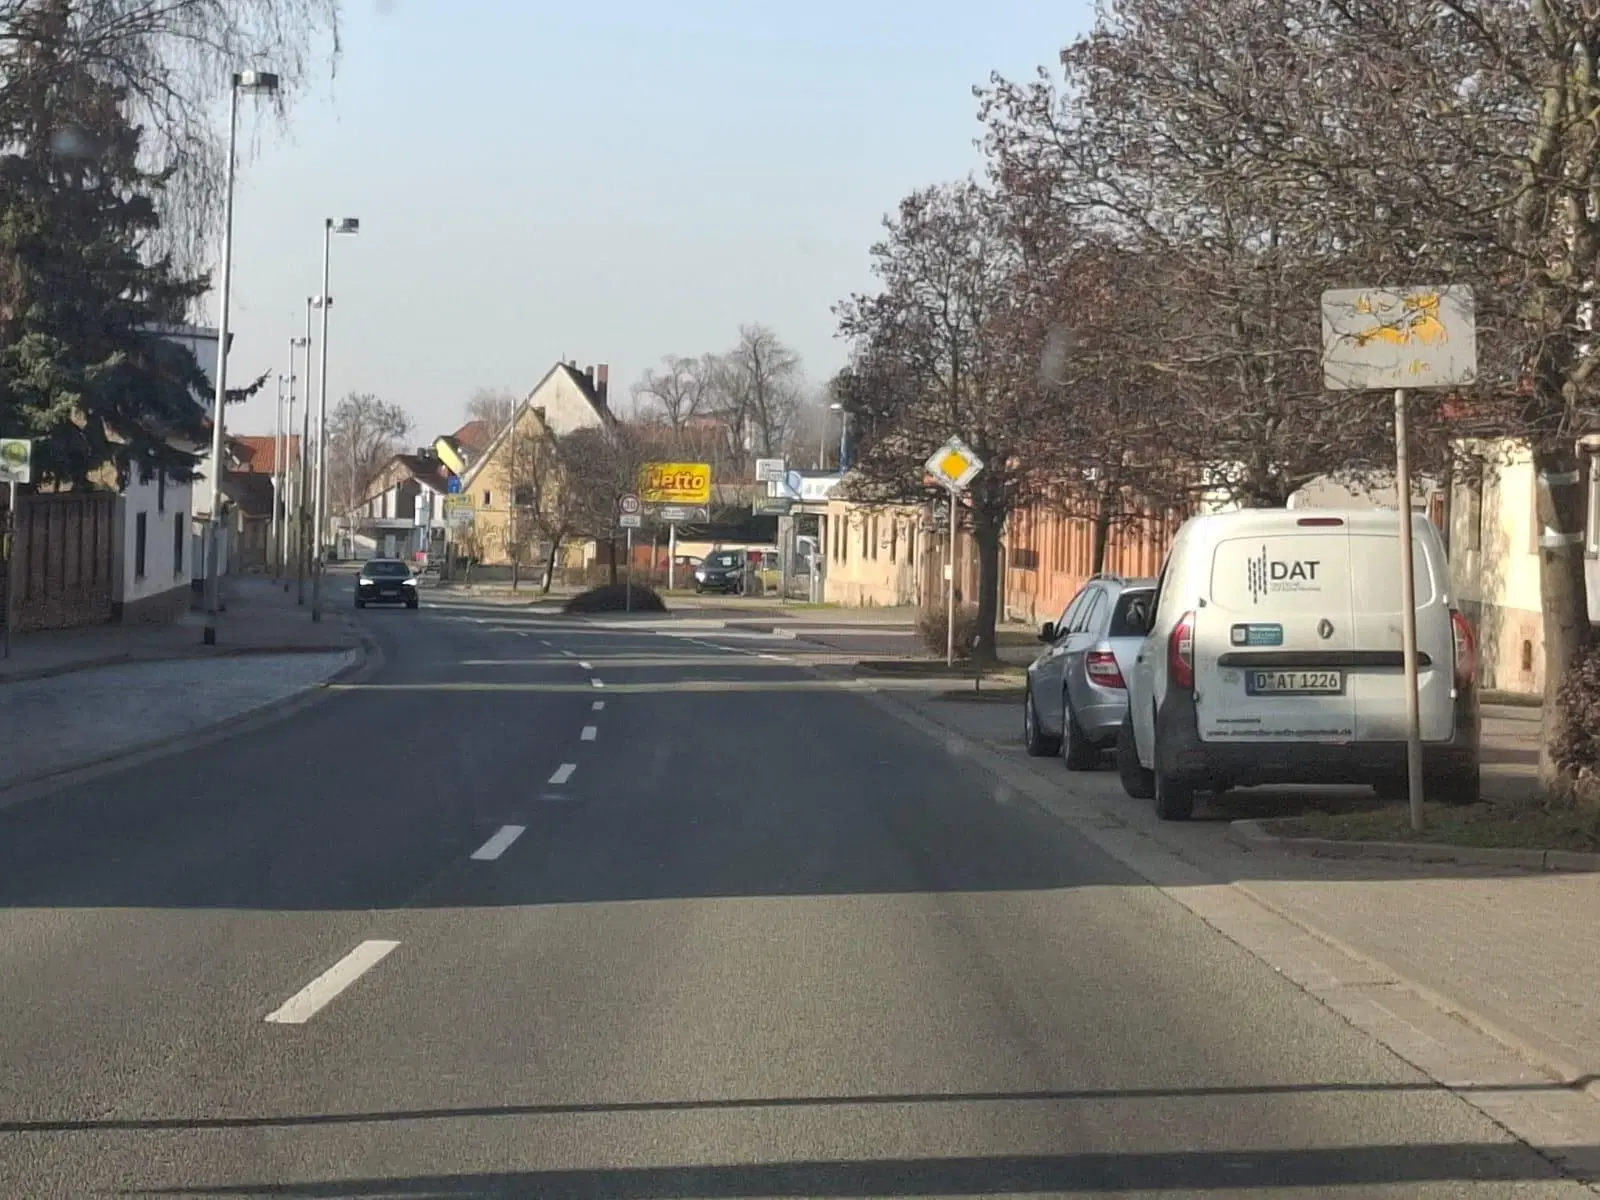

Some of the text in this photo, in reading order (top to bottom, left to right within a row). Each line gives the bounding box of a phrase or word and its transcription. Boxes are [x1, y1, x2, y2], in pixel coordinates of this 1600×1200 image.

[647, 468, 705, 490] Netto
[1270, 561, 1321, 581] DAT
[1276, 674, 1297, 689] AT
[1300, 674, 1338, 689] 1226
